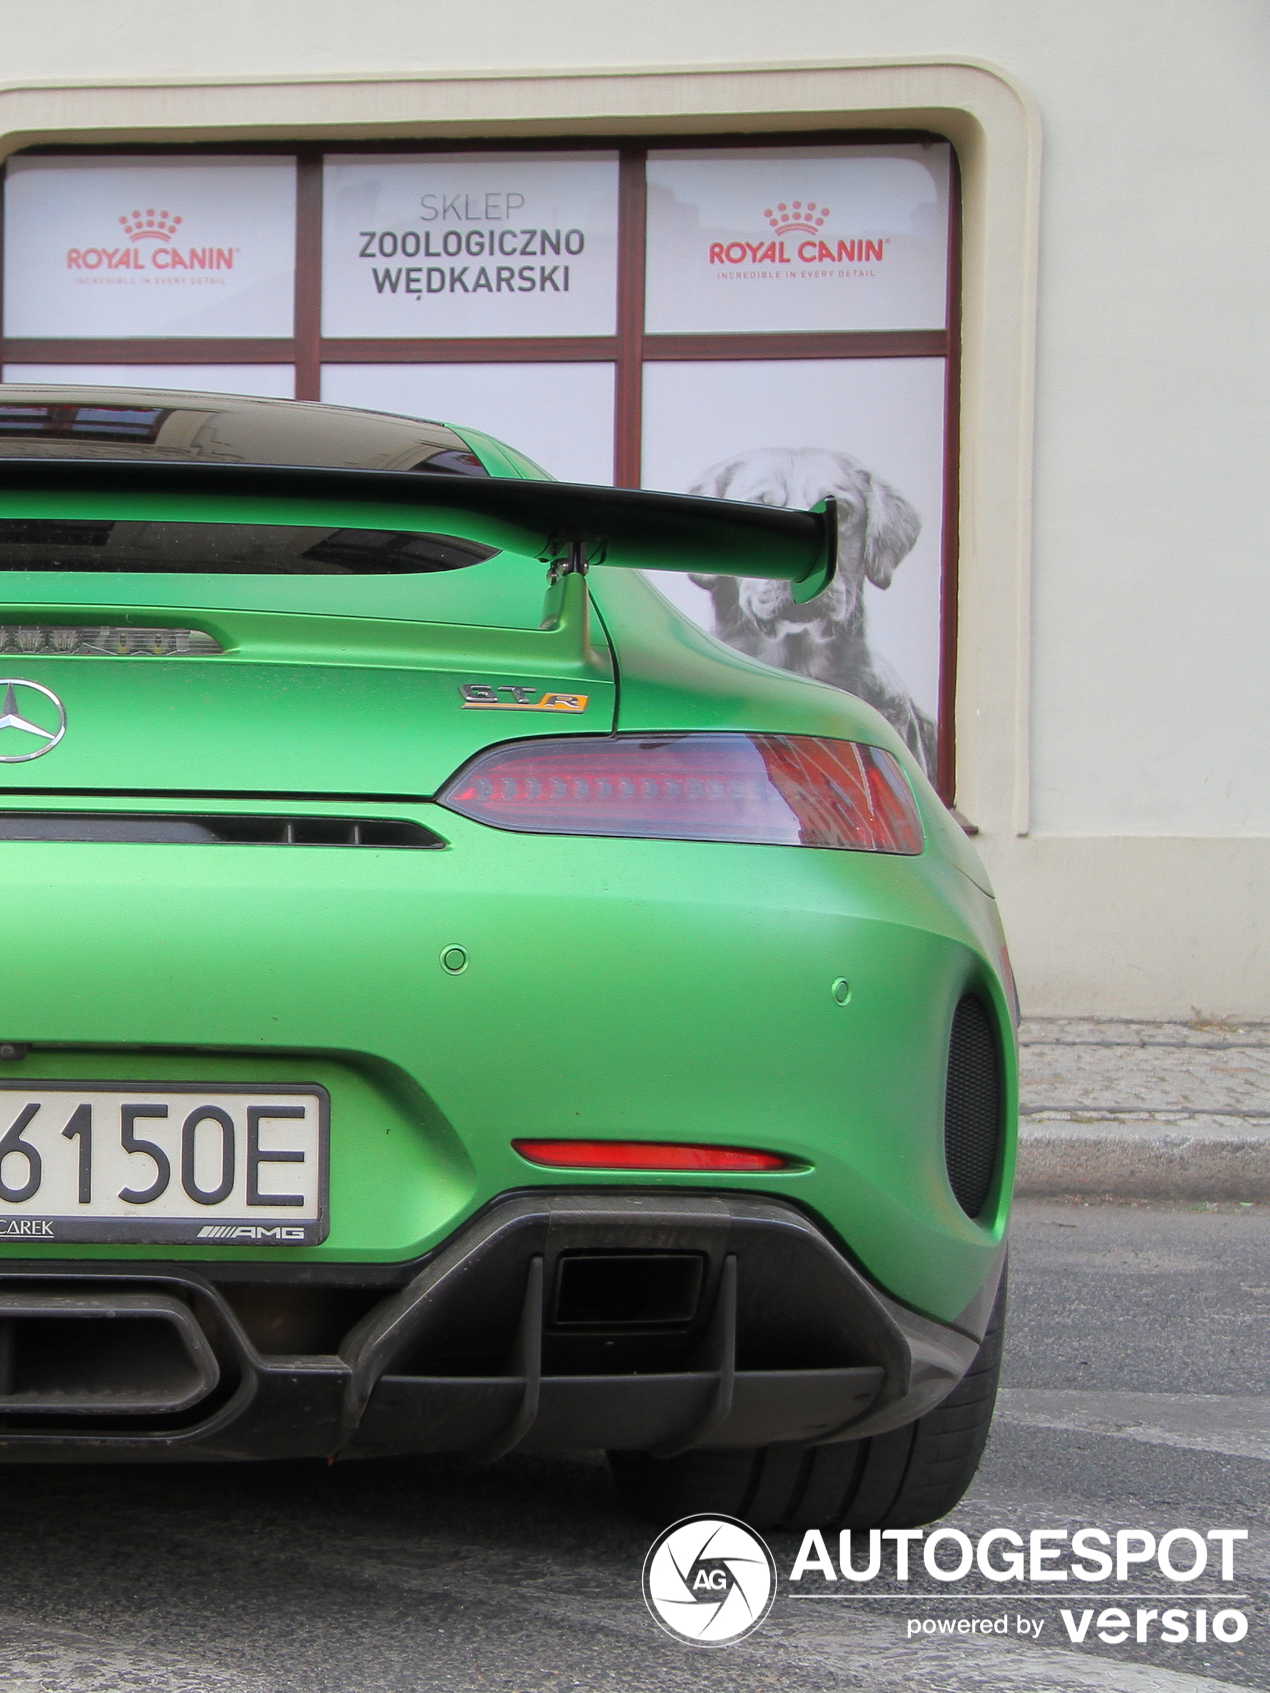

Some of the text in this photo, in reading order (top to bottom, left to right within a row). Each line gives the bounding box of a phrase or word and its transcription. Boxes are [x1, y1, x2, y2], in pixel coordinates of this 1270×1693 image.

[420, 193, 525, 221] SKLEP
[358, 229, 585, 258] ZOOLOGICZNO
[708, 238, 884, 265] ROYAL CANIN
[66, 247, 234, 270] ROYAL CANIN
[74, 276, 226, 285] INCREDIBLE IN EVERY DETAIL
[371, 265, 570, 301] WĘDKARSKI
[717, 269, 876, 280] INCREDIBLE IN EVERY DETAIL
[232, 1226, 305, 1239] AMG
